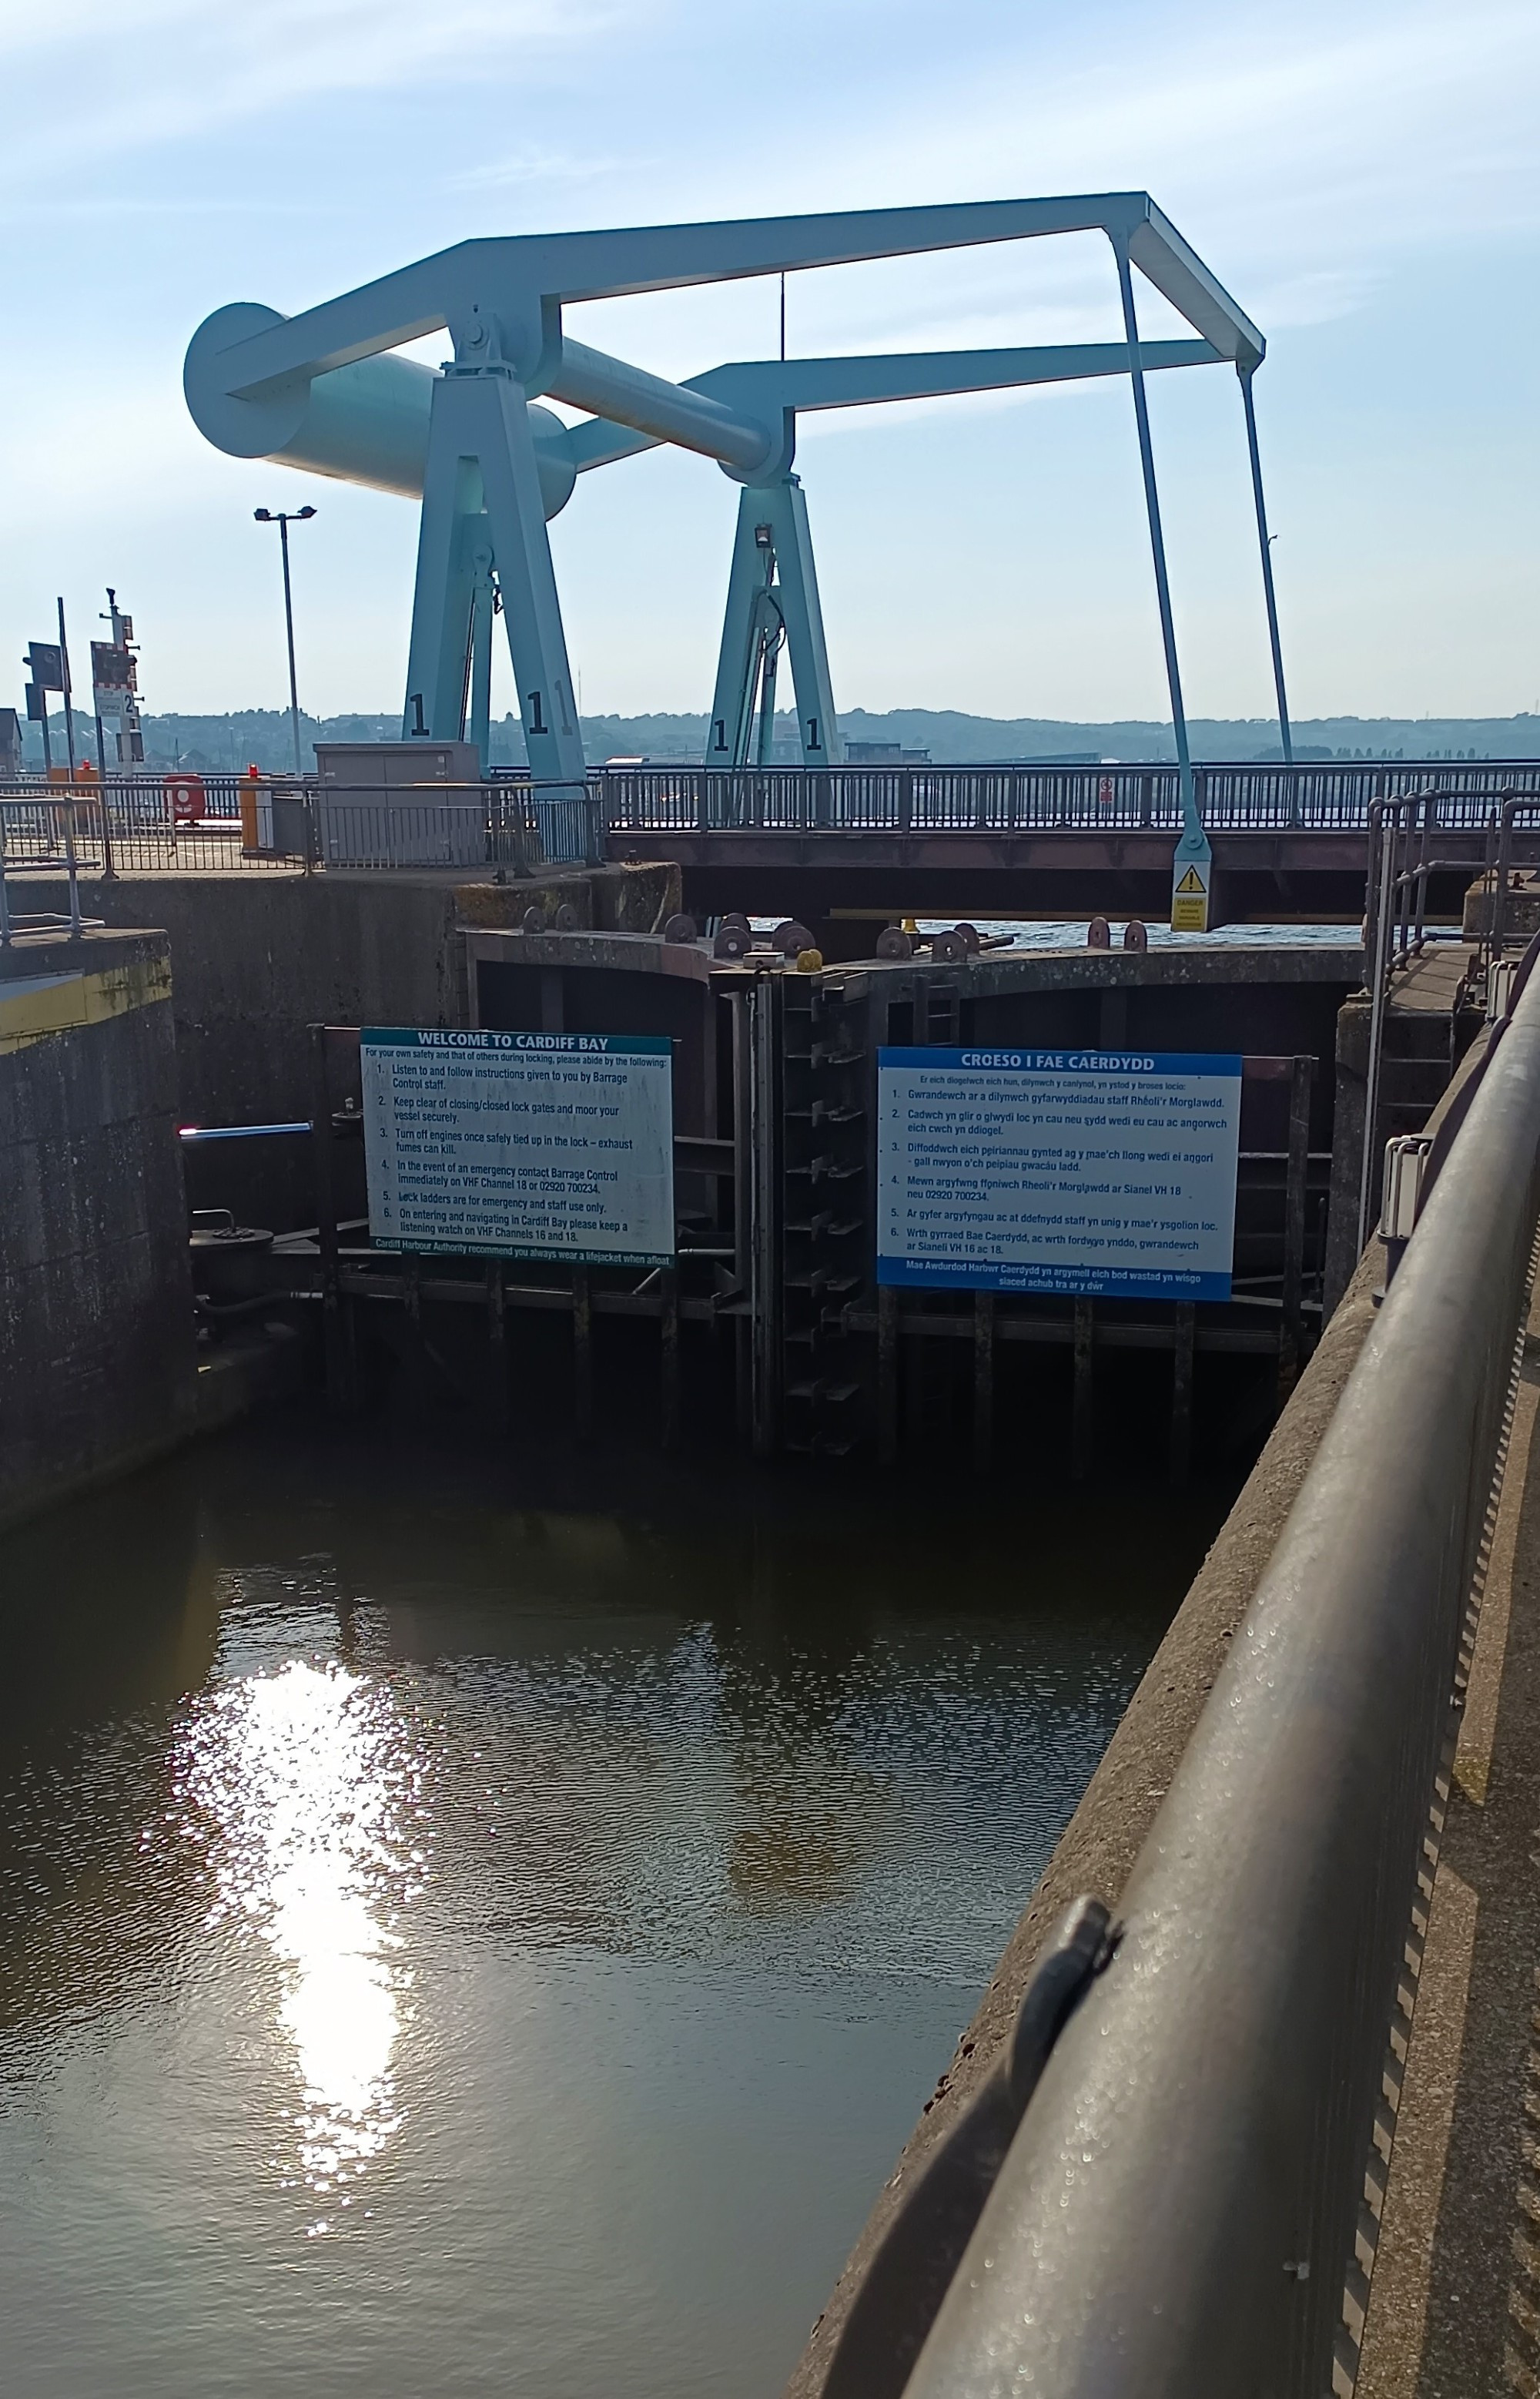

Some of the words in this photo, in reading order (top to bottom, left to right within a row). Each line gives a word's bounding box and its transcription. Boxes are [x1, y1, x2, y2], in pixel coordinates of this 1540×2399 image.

[125, 695, 133, 713] 2
[410, 692, 430, 736] 1
[527, 691, 548, 734] 1
[714, 719, 728, 751] 1
[806, 718, 822, 750] 1
[417, 1032, 489, 1046] WELCOME
[491, 1034, 512, 1047] TO
[515, 1035, 575, 1049] CARDIFF
[578, 1037, 608, 1050] BAY
[365, 1047, 377, 1057] For
[378, 1050, 395, 1059] your
[412, 1049, 435, 1060] safety
[435, 1050, 450, 1059] and
[450, 1050, 466, 1060] that
[466, 1050, 475, 1060] of
[475, 1051, 499, 1061] others
[500, 1052, 524, 1064] during
[525, 1053, 554, 1064] locking,
[556, 1054, 581, 1066] please
[582, 1055, 603, 1064] abide
[604, 1056, 614, 1067] by
[615, 1057, 628, 1065] the
[629, 1057, 667, 1069] following:
[961, 1053, 1021, 1067] CROESO
[1026, 1055, 1031, 1067] I
[1036, 1055, 1063, 1067] FAE
[1068, 1056, 1154, 1070] CAERDYDD
[376, 1064, 384, 1075] 1.
[391, 1064, 417, 1075] Listen
[418, 1065, 427, 1075] to
[429, 1065, 445, 1076] and
[447, 1066, 473, 1077] follow
[474, 1067, 525, 1081] instructions
[526, 1069, 551, 1081] given
[551, 1070, 561, 1081] to
[562, 1072, 578, 1082] you
[580, 1071, 591, 1083] by
[592, 1071, 628, 1084] Barrage
[392, 1077, 423, 1090] Control
[424, 1079, 447, 1091] staff.
[377, 1095, 386, 1105] 2.
[393, 1096, 414, 1108] Keep
[415, 1097, 437, 1109] clear
[438, 1098, 447, 1108] of
[448, 1098, 510, 1112] closing/closed
[511, 1101, 530, 1113] lock
[531, 1102, 555, 1114] gates
[556, 1103, 574, 1115] and
[574, 1106, 598, 1115] moor
[599, 1107, 619, 1117] your
[892, 1089, 899, 1097] 1.
[908, 1089, 966, 1100] Gwrandewch
[987, 1091, 1029, 1104] dilynwch
[1031, 1092, 1105, 1106] gyfarwyddiadau
[1106, 1094, 1129, 1105] staff
[1168, 1097, 1224, 1109] Morglawdd.
[393, 1110, 420, 1121] vessel
[421, 1111, 460, 1124] securely.
[891, 1108, 899, 1117] 2.
[907, 1109, 943, 1119] Cadwch
[945, 1112, 956, 1122] yn
[958, 1111, 974, 1122] glir
[983, 1111, 1014, 1124] glwydi
[1016, 1113, 1030, 1122] loc
[1032, 1115, 1043, 1124] yn
[1108, 1116, 1130, 1125] wedi
[1180, 1117, 1227, 1130] angorwch
[907, 1123, 926, 1132] eich
[928, 1124, 952, 1133] cwch
[954, 1126, 966, 1135] yn
[967, 1124, 1003, 1136] ddiogel.
[395, 1141, 422, 1152] fumes
[423, 1144, 439, 1154] can
[440, 1144, 456, 1154] kill.
[381, 1159, 389, 1169] 4.
[397, 1160, 406, 1170] In
[407, 1161, 421, 1171] the
[422, 1161, 446, 1172] event
[447, 1162, 457, 1172] of
[457, 1164, 468, 1173] an
[470, 1165, 516, 1178] emergency
[517, 1166, 550, 1179] contact
[551, 1168, 585, 1181] Barrage
[586, 1169, 618, 1181] Control
[397, 1173, 449, 1188] immediately
[450, 1178, 460, 1186] on
[461, 1177, 479, 1187] VHF
[480, 1178, 514, 1189] Channel
[516, 1179, 527, 1190] 18
[528, 1182, 538, 1191] or
[539, 1181, 565, 1192] 02920
[566, 1182, 600, 1194] 700234.
[925, 1189, 952, 1200] 02920
[954, 1190, 989, 1201] 700234.
[383, 1207, 392, 1218] 6.
[399, 1208, 411, 1219] On
[412, 1209, 447, 1222] entering
[448, 1211, 464, 1221] and
[466, 1211, 509, 1226] navigating
[511, 1215, 520, 1225] in
[521, 1215, 550, 1227] Cardiff
[551, 1217, 567, 1229] Bay
[568, 1218, 597, 1231] please
[598, 1219, 620, 1232] keep
[621, 1223, 628, 1231] a
[891, 1208, 899, 1217] 5.
[906, 1208, 917, 1218] Ar
[919, 1208, 942, 1221] gyfer
[943, 1210, 994, 1222] argyfyngau
[1009, 1213, 1019, 1222] at
[1019, 1213, 1063, 1225] ddefnydd
[1064, 1215, 1086, 1225] staff
[1086, 1218, 1099, 1227] yn
[1100, 1217, 1121, 1228] unig
[1123, 1219, 1129, 1228] y
[1130, 1218, 1158, 1228] mae'r
[1159, 1219, 1199, 1231] ysgolion
[1200, 1221, 1218, 1231] loc.
[400, 1221, 436, 1235] listening
[437, 1223, 463, 1235] watch
[464, 1227, 475, 1235] on
[476, 1225, 494, 1237] VHF
[494, 1226, 534, 1239] Channels
[535, 1229, 546, 1240] 16
[547, 1230, 564, 1241] and
[565, 1231, 578, 1241] 18.
[917, 1241, 947, 1251] Sianeli
[949, 1242, 962, 1252] VH
[964, 1244, 975, 1253] 16
[990, 1245, 1003, 1254] 18.
